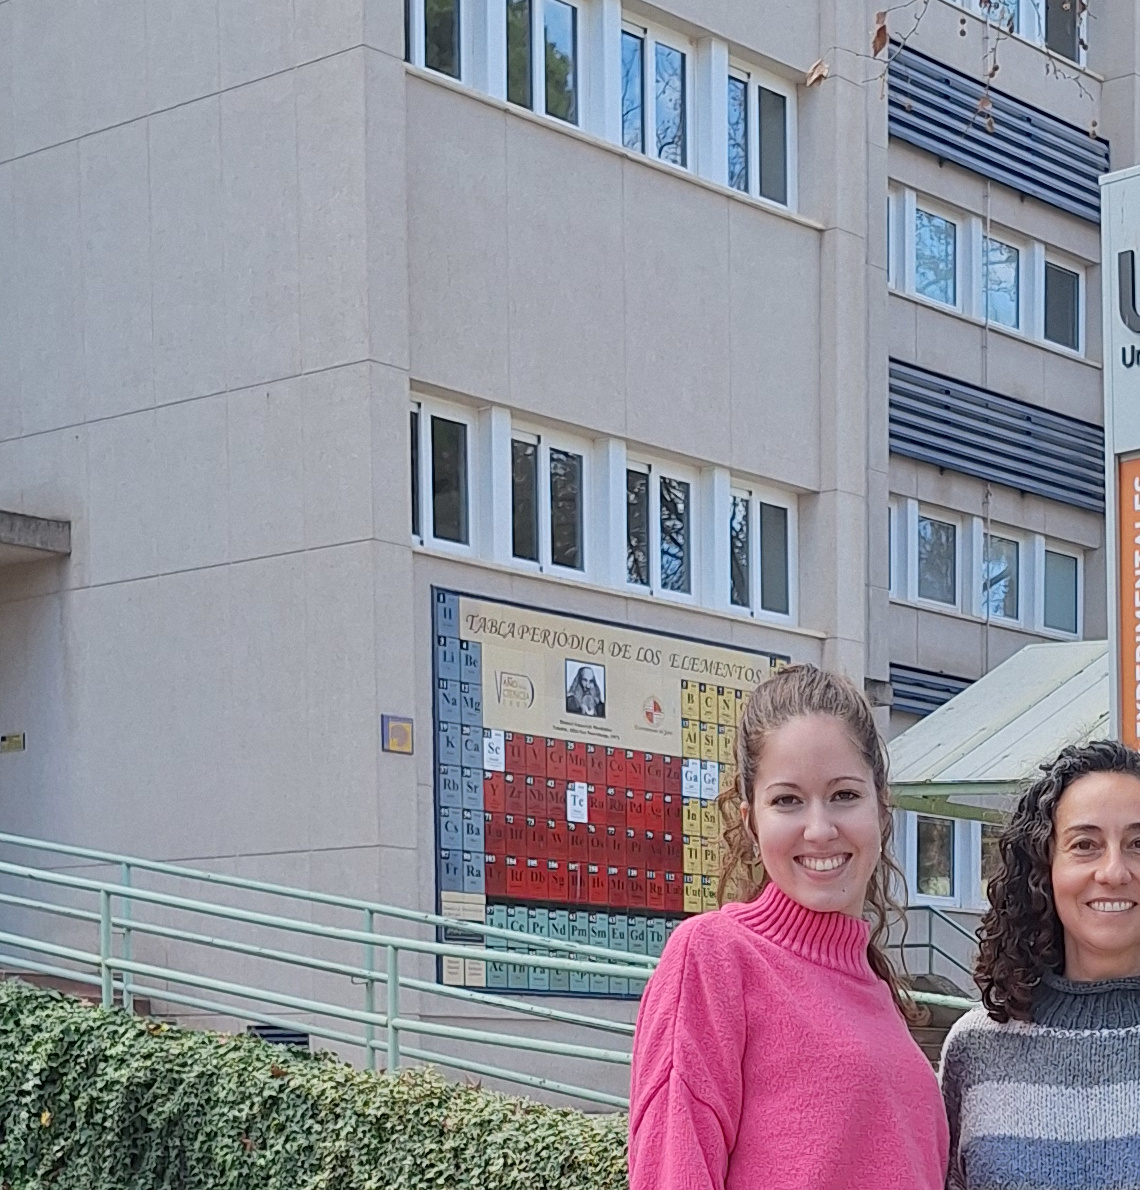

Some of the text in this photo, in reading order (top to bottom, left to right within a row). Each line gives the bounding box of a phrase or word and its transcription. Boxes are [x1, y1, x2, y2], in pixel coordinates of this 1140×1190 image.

[465, 614, 763, 685] TABLA PERIÓDICA DE LOS ELEMENTOS
[688, 693, 694, 704] B
[705, 696, 712, 707] C
[723, 699, 730, 710] N
[446, 735, 455, 748] K
[464, 738, 480, 752] Ca
[487, 741, 501, 755] Sc
[549, 751, 563, 763] Cr
[684, 770, 698, 783] Ga
[703, 772, 717, 785] Ge
[443, 778, 459, 791] Rb
[466, 780, 479, 794] Sr
[490, 783, 499, 796] Y
[571, 794, 584, 807] Tc
[687, 808, 697, 821] In
[703, 811, 716, 824] Sn
[444, 820, 459, 833] Cs
[466, 822, 480, 836] Ba
[688, 847, 698, 860] Tl
[466, 865, 481, 878] Ra
[530, 871, 545, 883] Db
[533, 922, 546, 934] Pr
[551, 923, 566, 936] Nd
[571, 925, 587, 937] Pm
[591, 926, 607, 938] Sm
[612, 928, 625, 939] Eu
[631, 929, 645, 941] Gd
[650, 931, 663, 942] Tb
